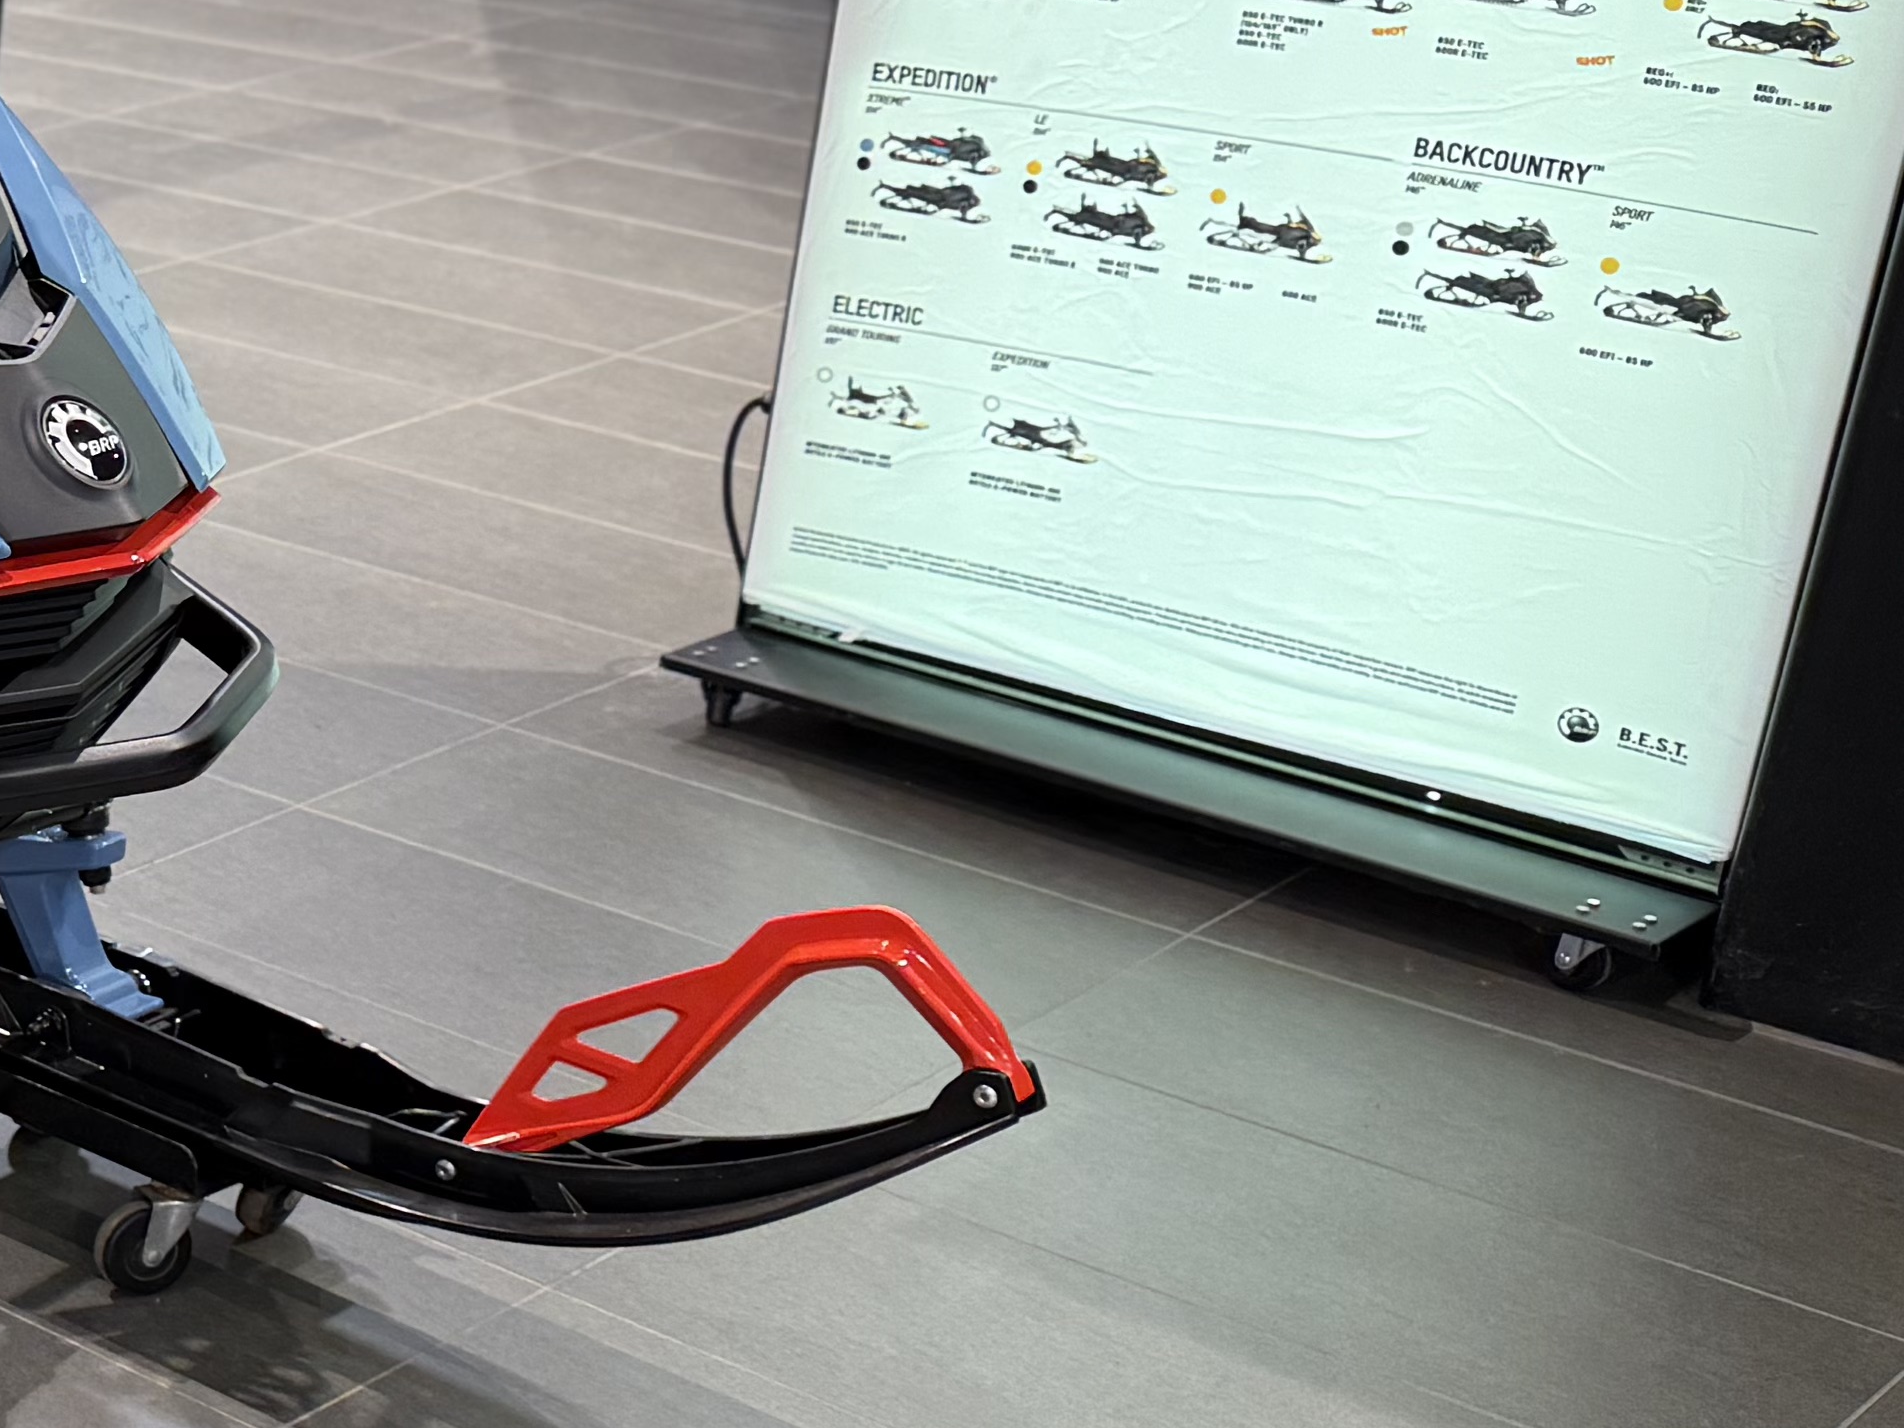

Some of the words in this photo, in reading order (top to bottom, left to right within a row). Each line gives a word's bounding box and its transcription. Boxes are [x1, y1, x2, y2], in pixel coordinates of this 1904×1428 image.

[1576, 55, 1615, 66] SHOT
[1214, 140, 1251, 156] SPORT
[1406, 171, 1483, 193] ADRENALINE
[1612, 205, 1654, 222] SPORT
[832, 294, 924, 326] ELECTRIC
[88, 434, 120, 456] BRP
[1619, 727, 1688, 759] B.E.S.T.
